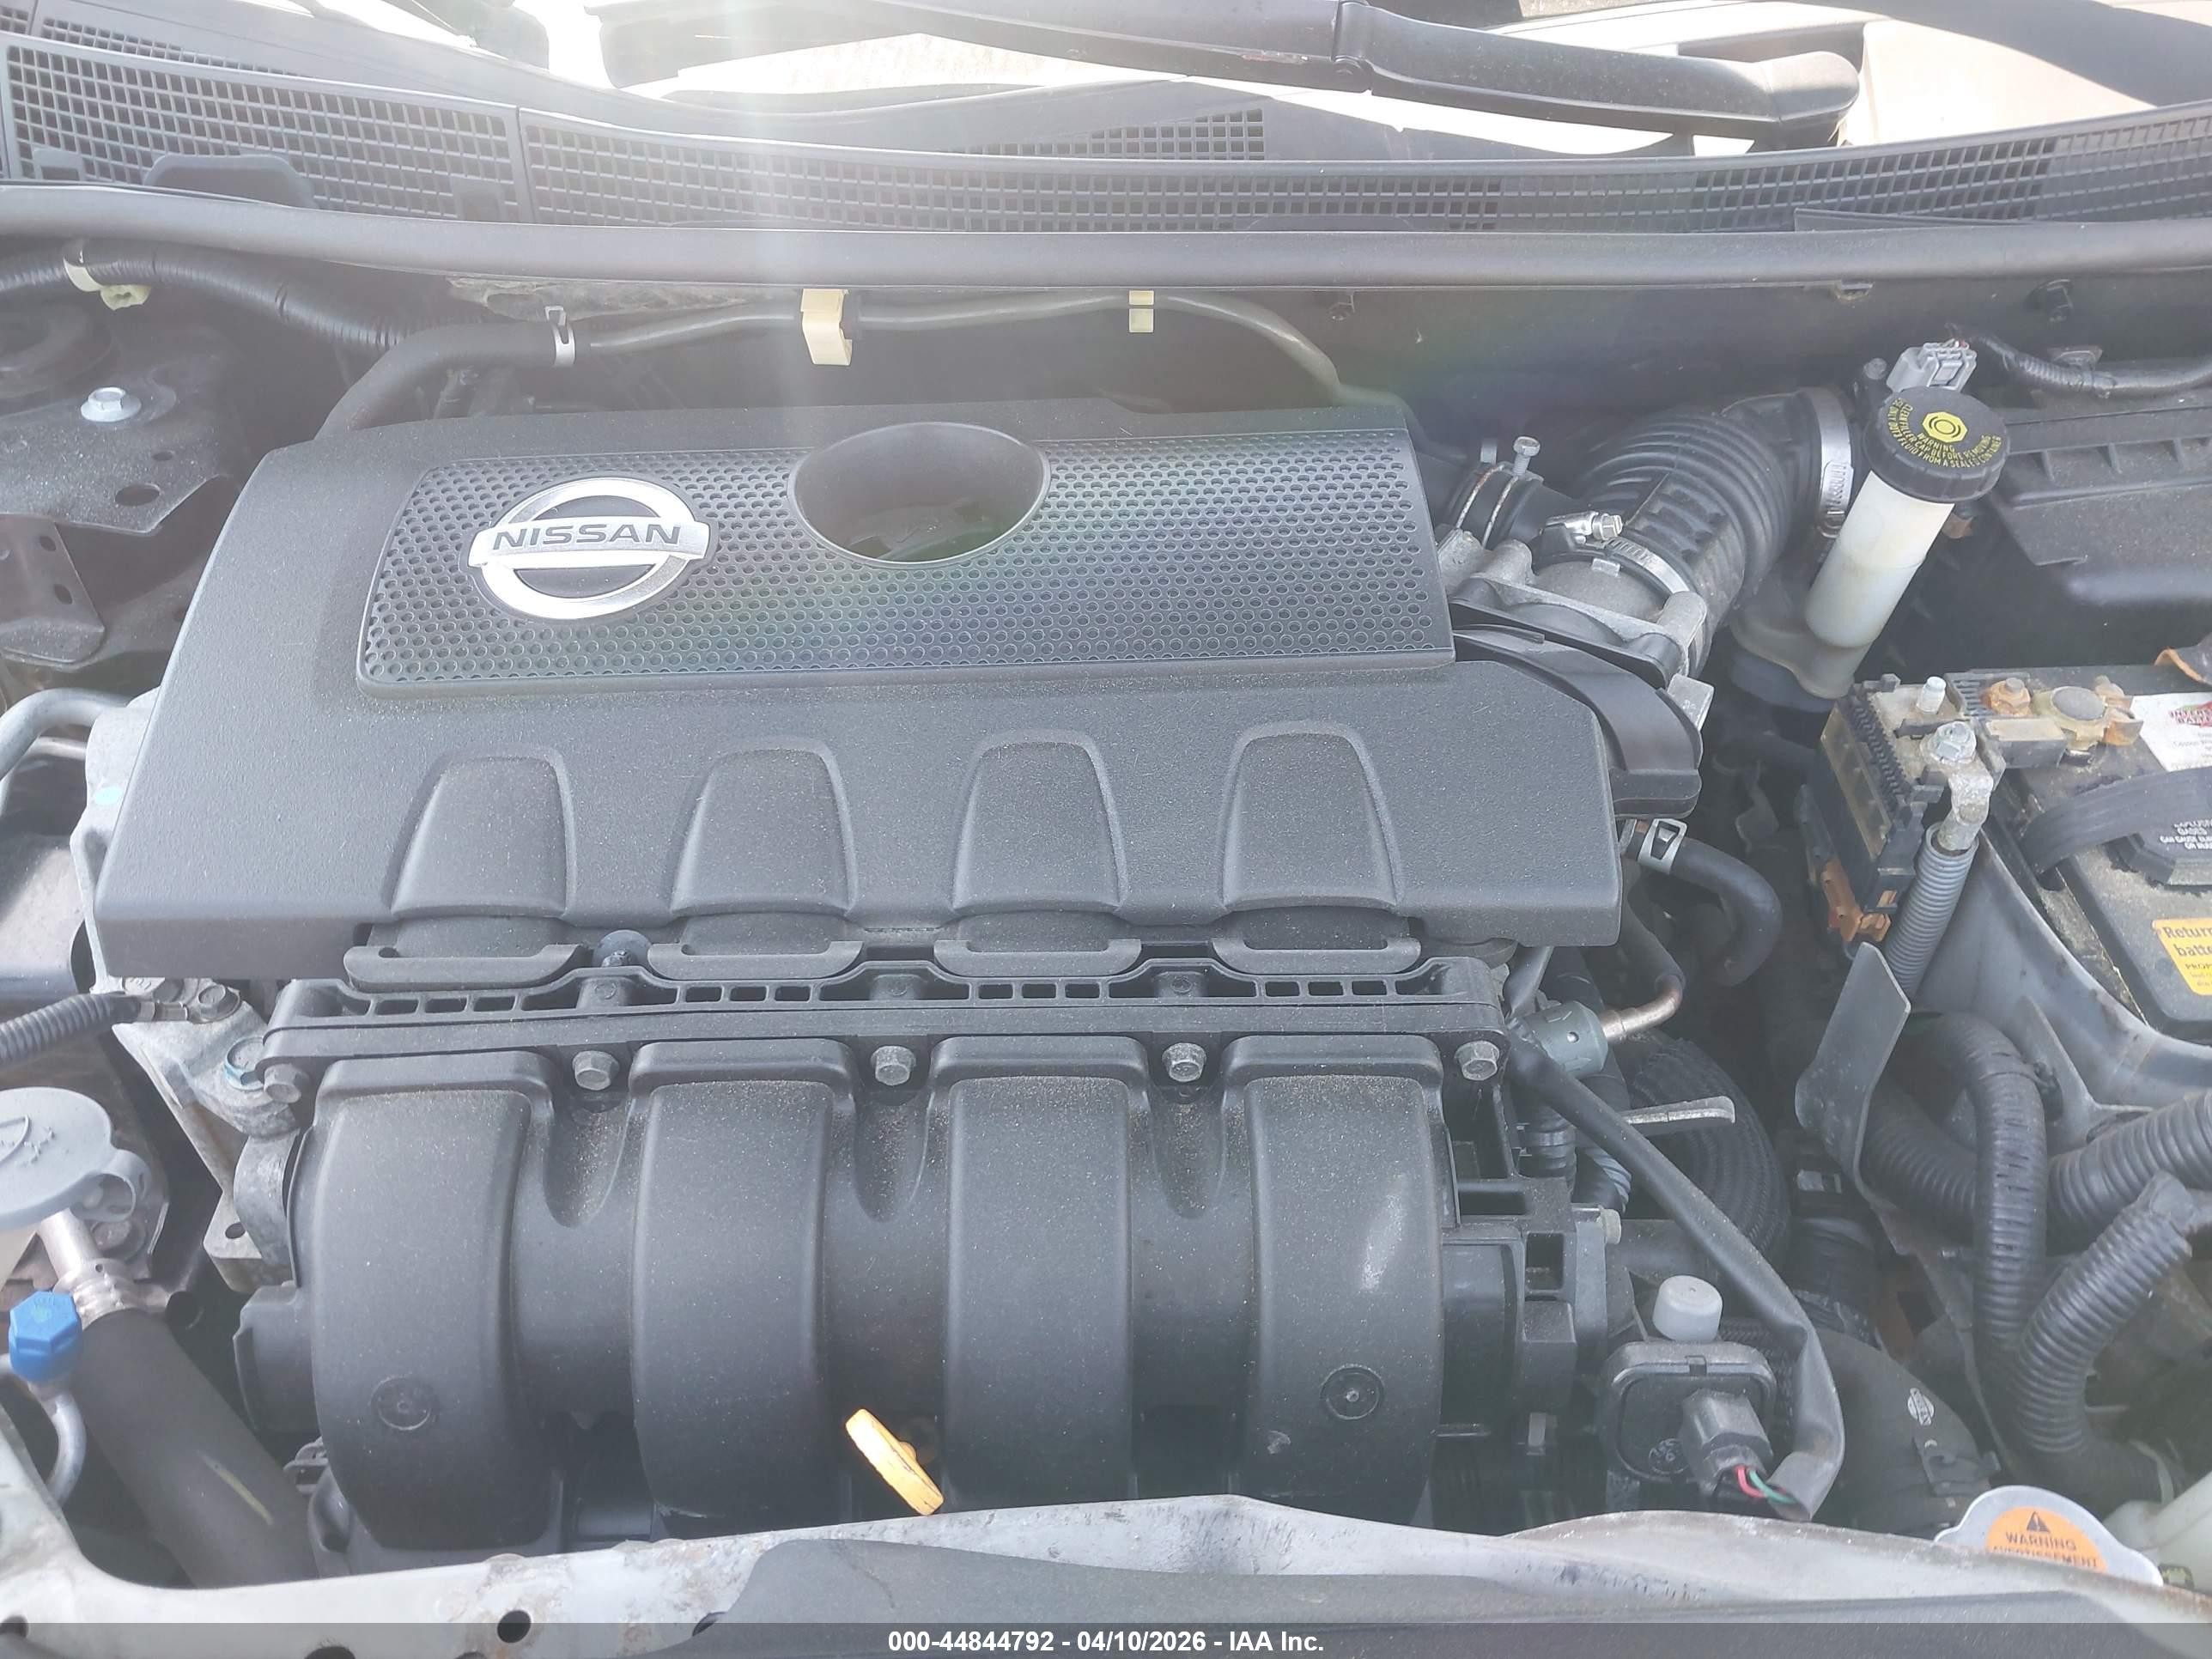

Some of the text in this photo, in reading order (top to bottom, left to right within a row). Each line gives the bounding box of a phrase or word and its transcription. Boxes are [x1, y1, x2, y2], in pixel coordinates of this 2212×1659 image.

[1917, 432, 1956, 453] WARNING
[493, 524, 681, 550] NISSAN
[2005, 1531, 2076, 1551] WARNING
